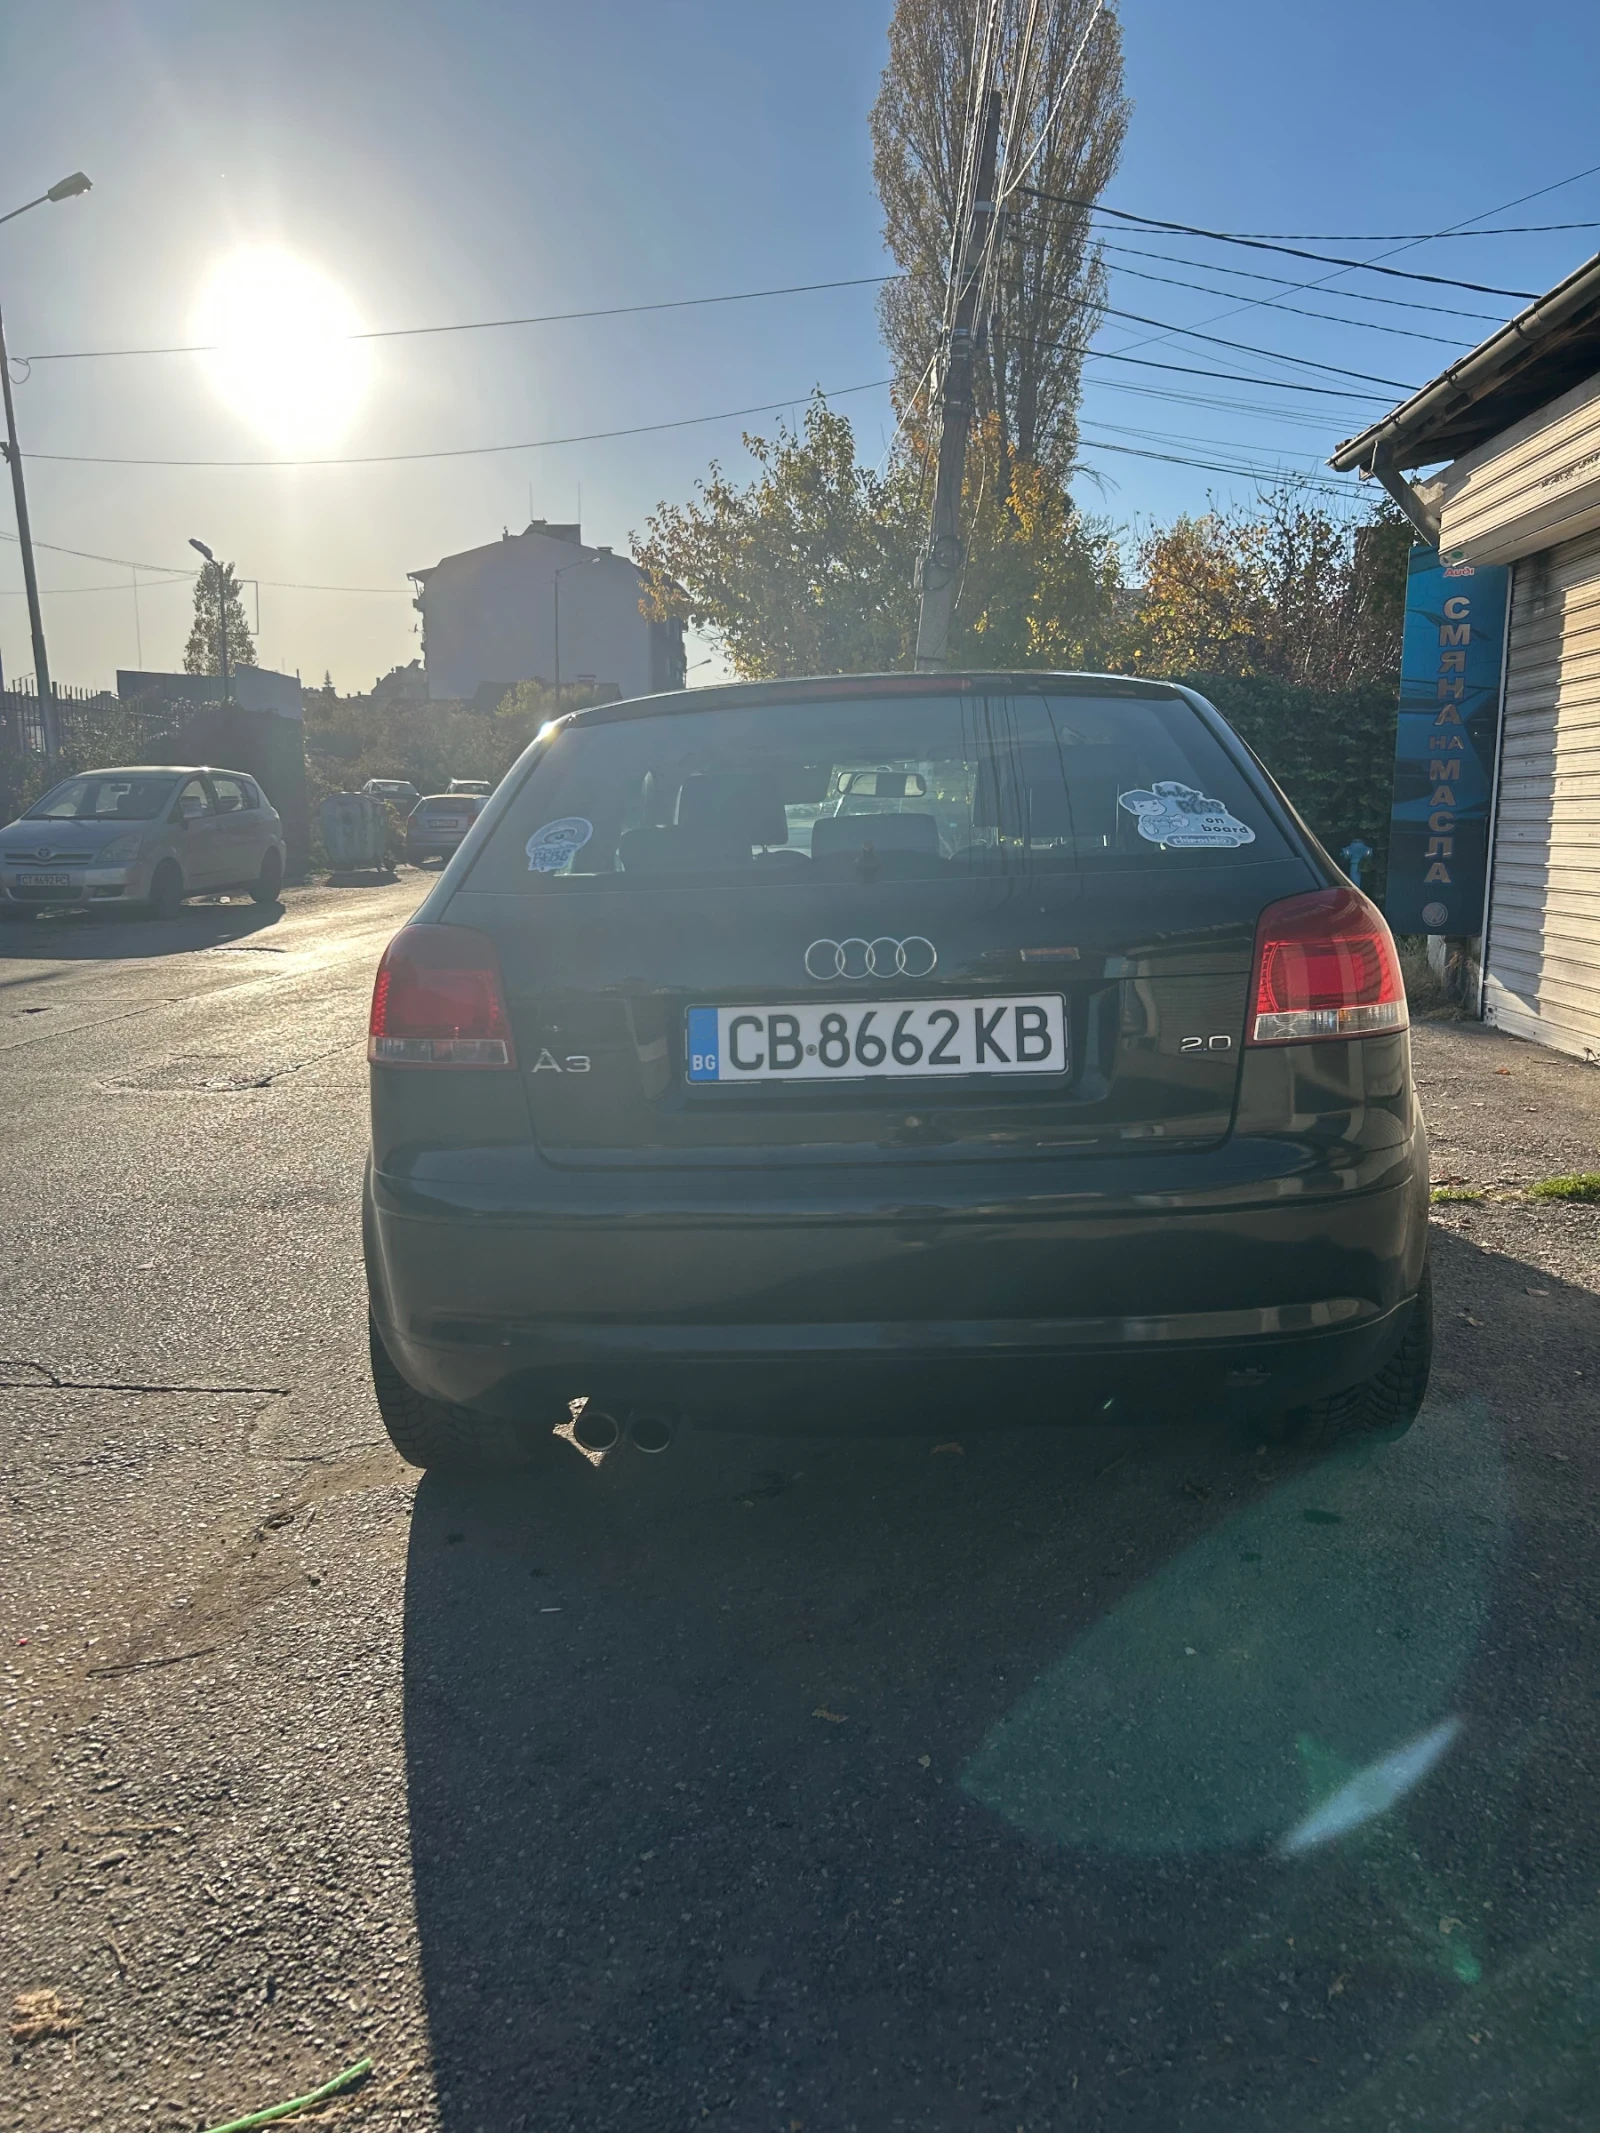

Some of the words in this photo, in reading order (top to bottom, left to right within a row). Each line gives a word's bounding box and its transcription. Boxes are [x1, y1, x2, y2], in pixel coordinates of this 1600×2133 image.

[1443, 567, 1475, 578] Audi
[1434, 596, 1471, 726] СМЯНА
[1428, 735, 1464, 750] НА
[1155, 784, 1202, 803] baby
[1200, 824, 1249, 834] board
[1424, 759, 1461, 883] МАСЛА
[729, 1014, 804, 1071] CB
[818, 1009, 961, 1069] 8662
[974, 1005, 1052, 1064] KB
[531, 1047, 591, 1073] A3
[692, 1054, 716, 1071] BG
